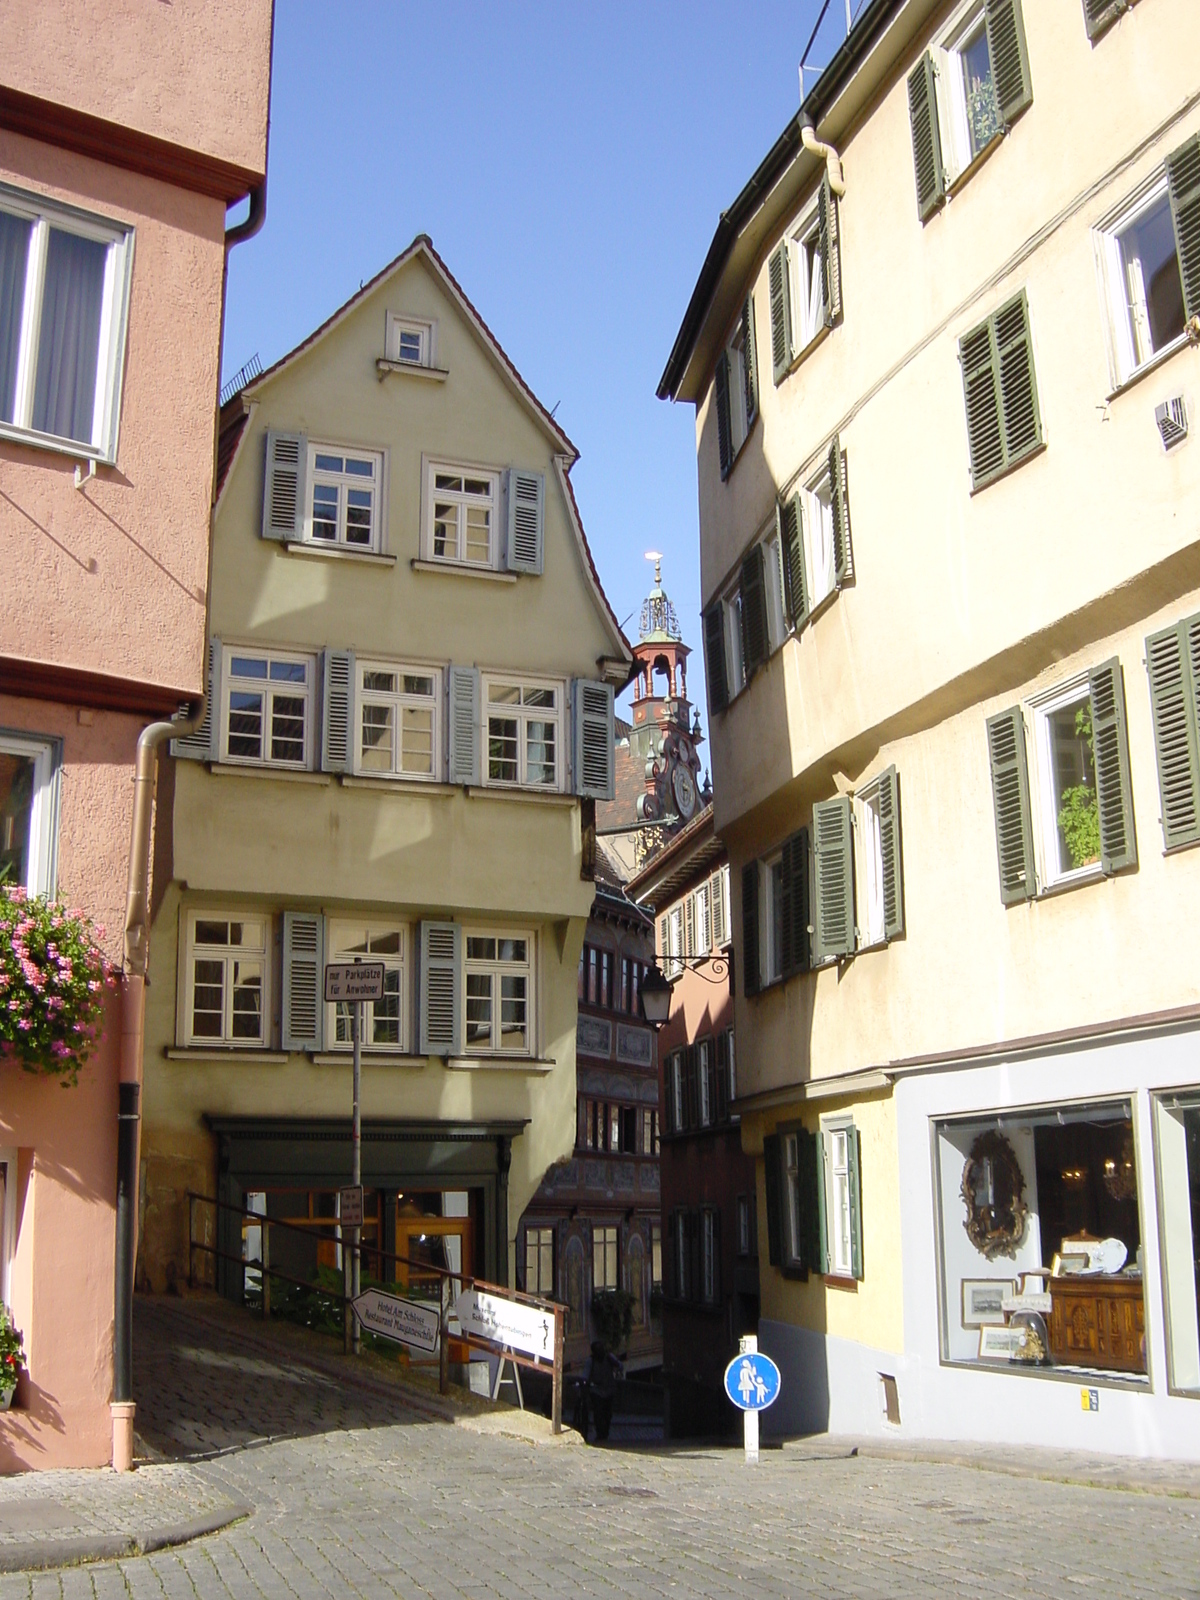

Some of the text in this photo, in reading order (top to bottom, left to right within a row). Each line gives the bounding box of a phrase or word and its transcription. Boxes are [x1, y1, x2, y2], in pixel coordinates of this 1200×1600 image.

[345, 969, 381, 980] Parkplätze
[330, 984, 378, 995] für Anwohner
[377, 1300, 393, 1315] Hotel
[364, 1308, 393, 1328] Restaurant
